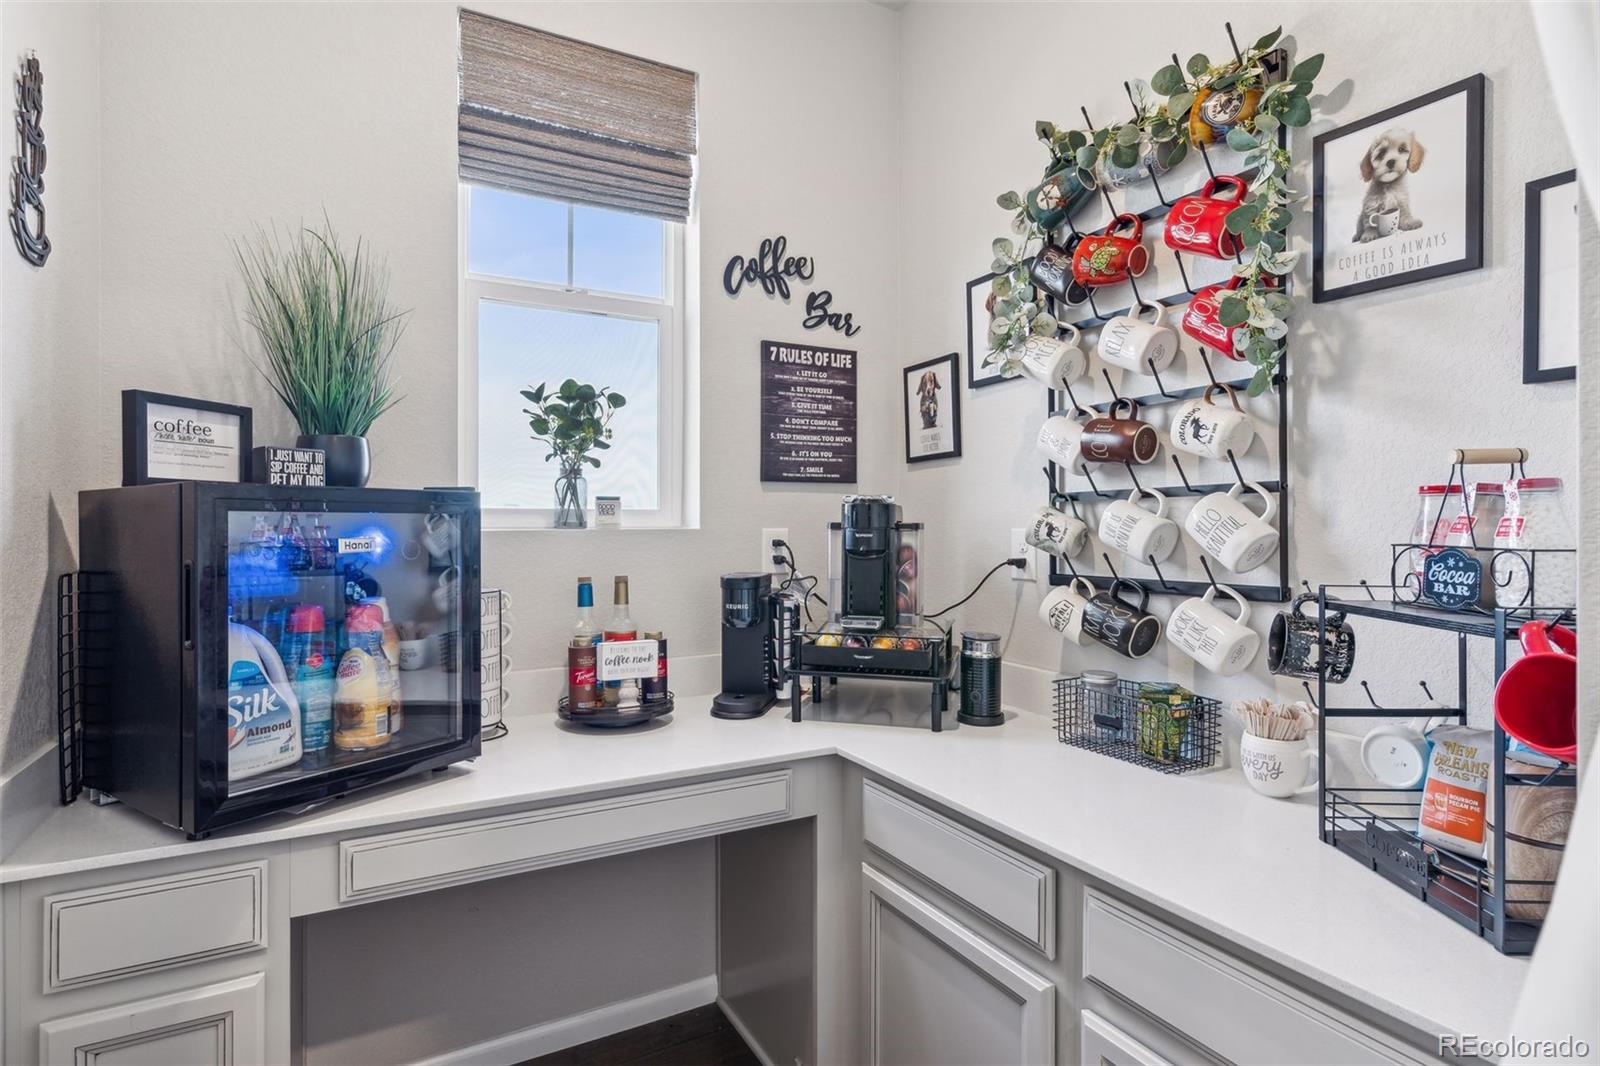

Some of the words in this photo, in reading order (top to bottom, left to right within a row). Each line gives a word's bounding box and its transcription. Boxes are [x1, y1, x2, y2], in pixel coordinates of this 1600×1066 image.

[1338, 250, 1375, 271] COFFEE
[1382, 246, 1394, 259] IS
[1400, 232, 1447, 255] ALWAYS
[723, 235, 815, 300] Coffee
[1353, 271, 1359, 281] A
[1364, 262, 1394, 279] GOOD
[1402, 254, 1430, 271] IDEA
[802, 290, 861, 337] Bar
[1104, 321, 1135, 358] RELAX
[769, 346, 778, 361] 7
[779, 347, 813, 365] RULES
[814, 352, 830, 367] OF
[831, 353, 852, 369] LIFE
[804, 387, 833, 395] YOURSELF
[810, 419, 838, 427] COMPARE
[1178, 407, 1201, 446] COLORADO
[270, 461, 283, 472] SIP
[284, 462, 308, 474] COFFEE
[310, 464, 324, 475] AND
[274, 450, 293, 461] JUST
[294, 450, 313, 462] WANT
[315, 452, 324, 463] TO
[270, 474, 287, 485] PET
[290, 474, 304, 486] MY
[306, 476, 324, 486] DOG
[1115, 514, 1142, 552] BEAUTIFUL
[1194, 508, 1222, 540] HELLO
[1206, 515, 1247, 558] BEAUTIFUL
[1428, 560, 1476, 585] Cocoa
[1433, 582, 1470, 596] BAR
[1100, 606, 1133, 647] WORKS
[1173, 610, 1195, 637] WOKE
[1186, 620, 1208, 642] LIKE
[1198, 633, 1219, 656] THIS
[605, 655, 630, 666] coffee
[632, 652, 654, 664] nook
[228, 687, 280, 728] Silk
[246, 719, 292, 738] Almond
[1442, 740, 1478, 760] NEW
[1253, 770, 1269, 782] DAY
[1433, 752, 1490, 780] ORLEANS
[1437, 766, 1480, 783] ROAST
[1448, 793, 1479, 807] BOURBON
[1448, 799, 1470, 810] PECAN
[1470, 805, 1481, 813] PIE
